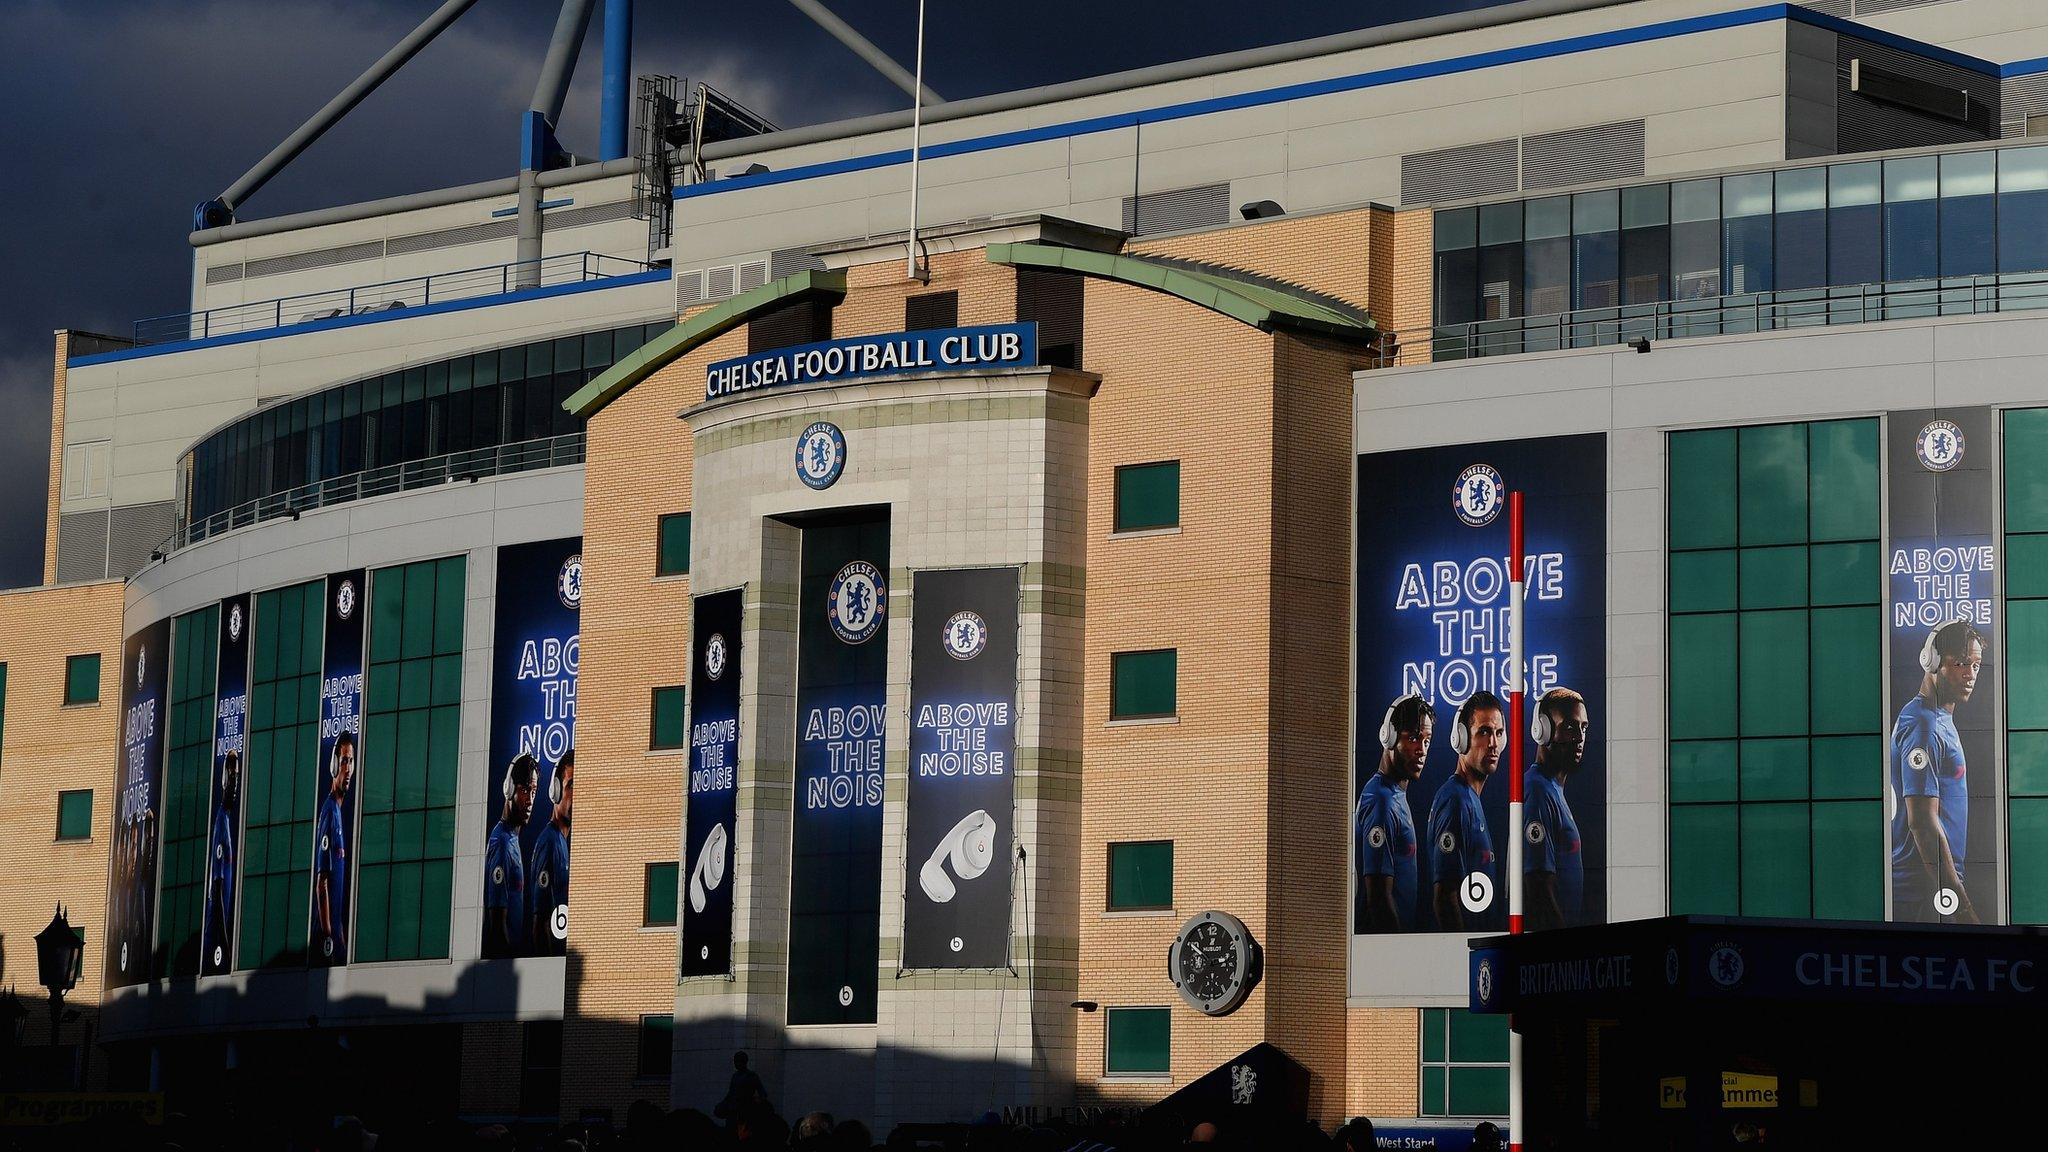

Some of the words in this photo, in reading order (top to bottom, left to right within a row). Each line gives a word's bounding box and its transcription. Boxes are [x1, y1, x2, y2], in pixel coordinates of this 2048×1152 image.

[707, 356, 788, 397] CHELSEA
[794, 339, 933, 380] FOOTBALL
[940, 332, 1020, 364] CLUB
[803, 424, 835, 440] CHELSEA
[1924, 422, 1956, 434] CHELSEA
[1461, 466, 1495, 481] CHELSEA
[1890, 546, 1994, 574] ABOVE
[838, 563, 877, 583] CHELSEA
[1396, 553, 1563, 609] ABOVE
[1914, 574, 1970, 599] THE
[950, 613, 979, 624] CHELSEA
[1895, 600, 1991, 627] NOISE
[836, 626, 862, 640] FOOTBALL
[862, 623, 876, 637] CLUB
[517, 635, 580, 680] ABO
[322, 674, 362, 698] ABOVE
[217, 695, 246, 718] ABOVE
[331, 696, 353, 717] THE
[541, 679, 579, 719] TH
[125, 699, 155, 747] ABOVE
[223, 716, 238, 736] THE
[322, 715, 359, 738] NOISE
[805, 704, 887, 741] ABOV
[917, 703, 1008, 727] ABOVE
[692, 719, 735, 746] ABOVE
[937, 727, 986, 751] THE
[217, 734, 243, 757] NOISE
[700, 744, 724, 769] THE
[828, 739, 881, 773] THE
[129, 743, 145, 785] THE
[920, 752, 1004, 776] NOISE
[692, 766, 732, 793] NOISE
[808, 773, 883, 809] NOIS
[121, 782, 150, 826] NOISE
[1207, 926, 1217, 935] 12
[1519, 959, 1592, 996] BRITANNIA
[1594, 954, 1633, 989] GATE
[1794, 952, 1975, 992] CHELSEA
[1986, 959, 2036, 993] FC
[1376, 1137, 1401, 1149] West
[1405, 1137, 1435, 1149] Stand
